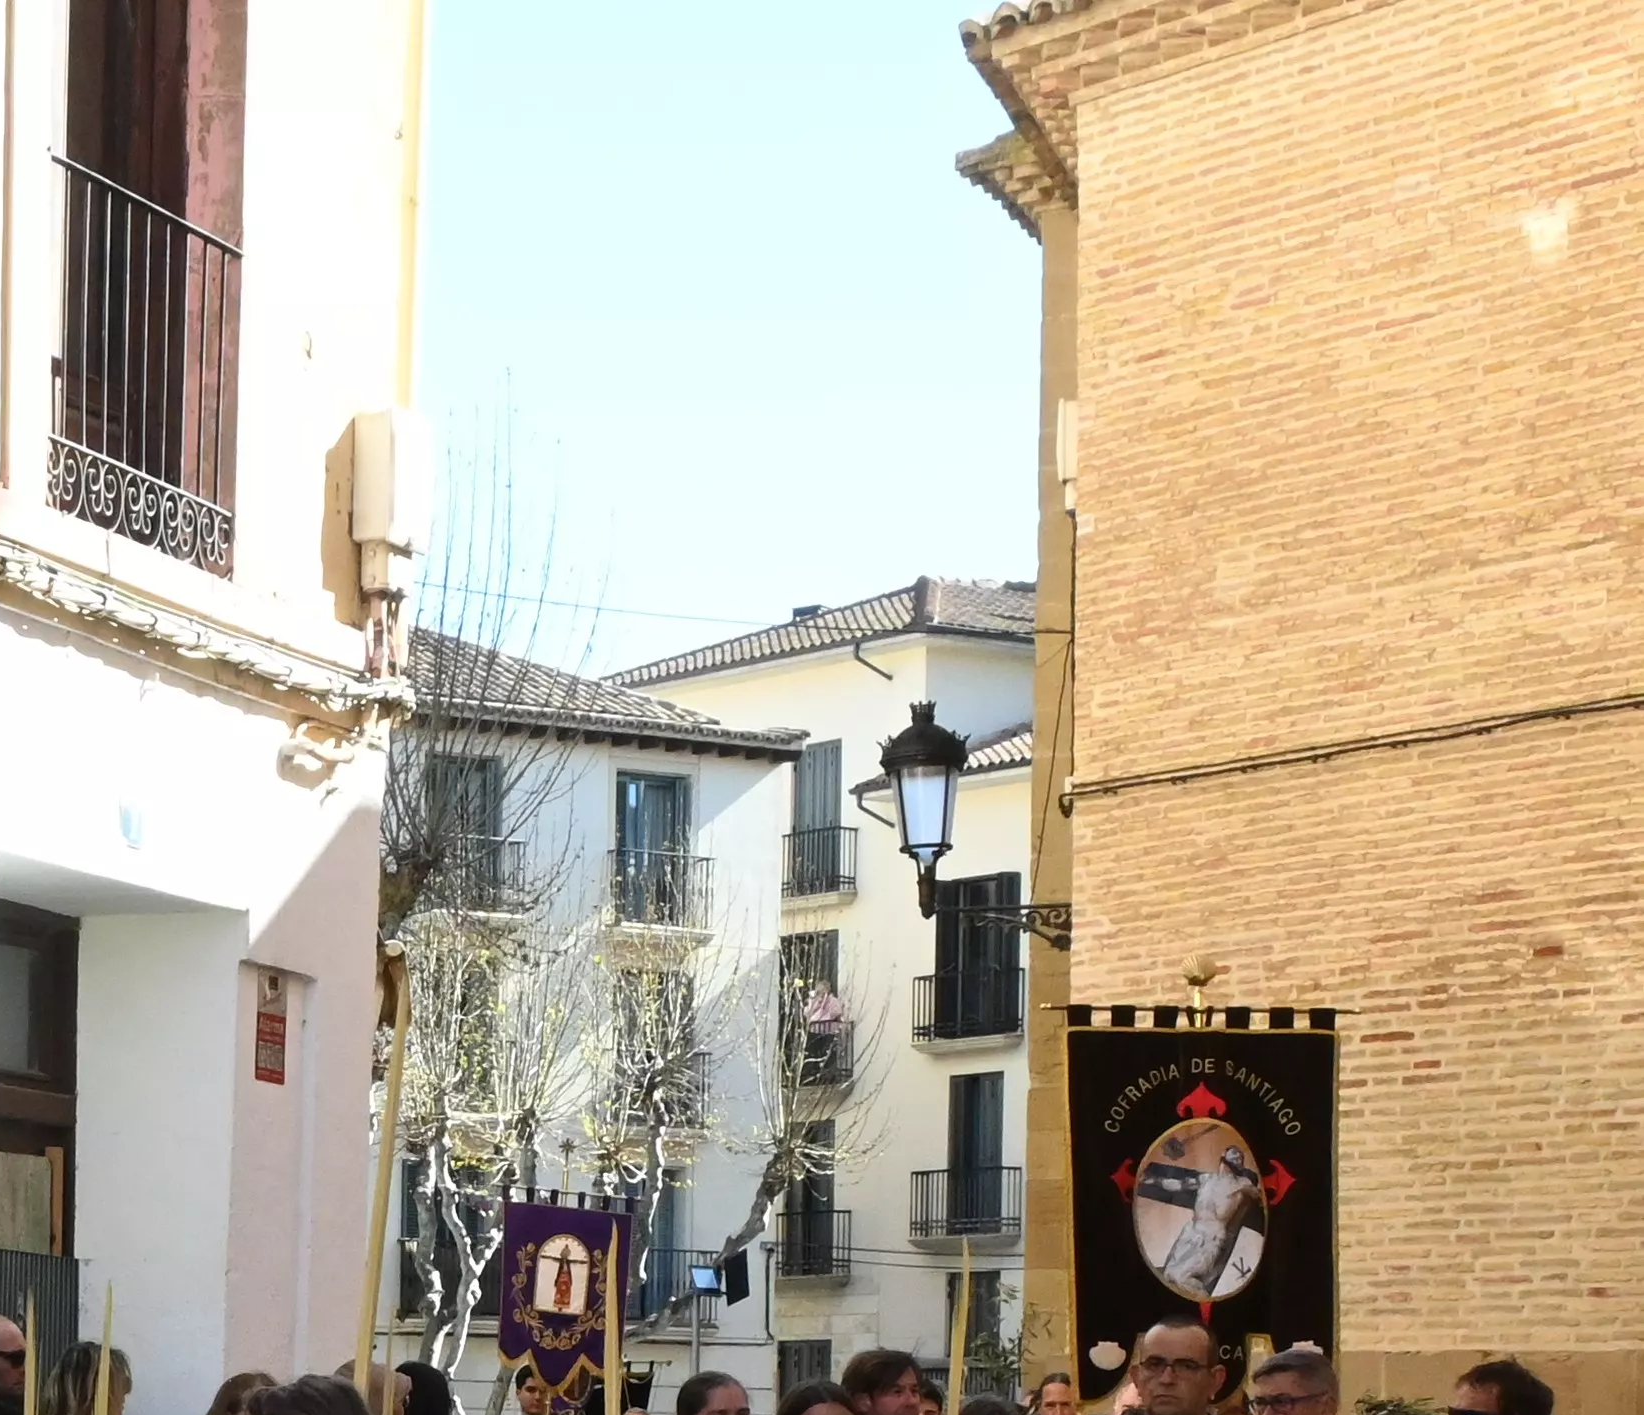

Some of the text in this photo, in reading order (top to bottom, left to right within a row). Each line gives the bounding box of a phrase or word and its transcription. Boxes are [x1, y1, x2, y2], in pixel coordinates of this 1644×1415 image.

[1104, 1058, 1302, 1136] COFRADIA DE SANTIAGO
